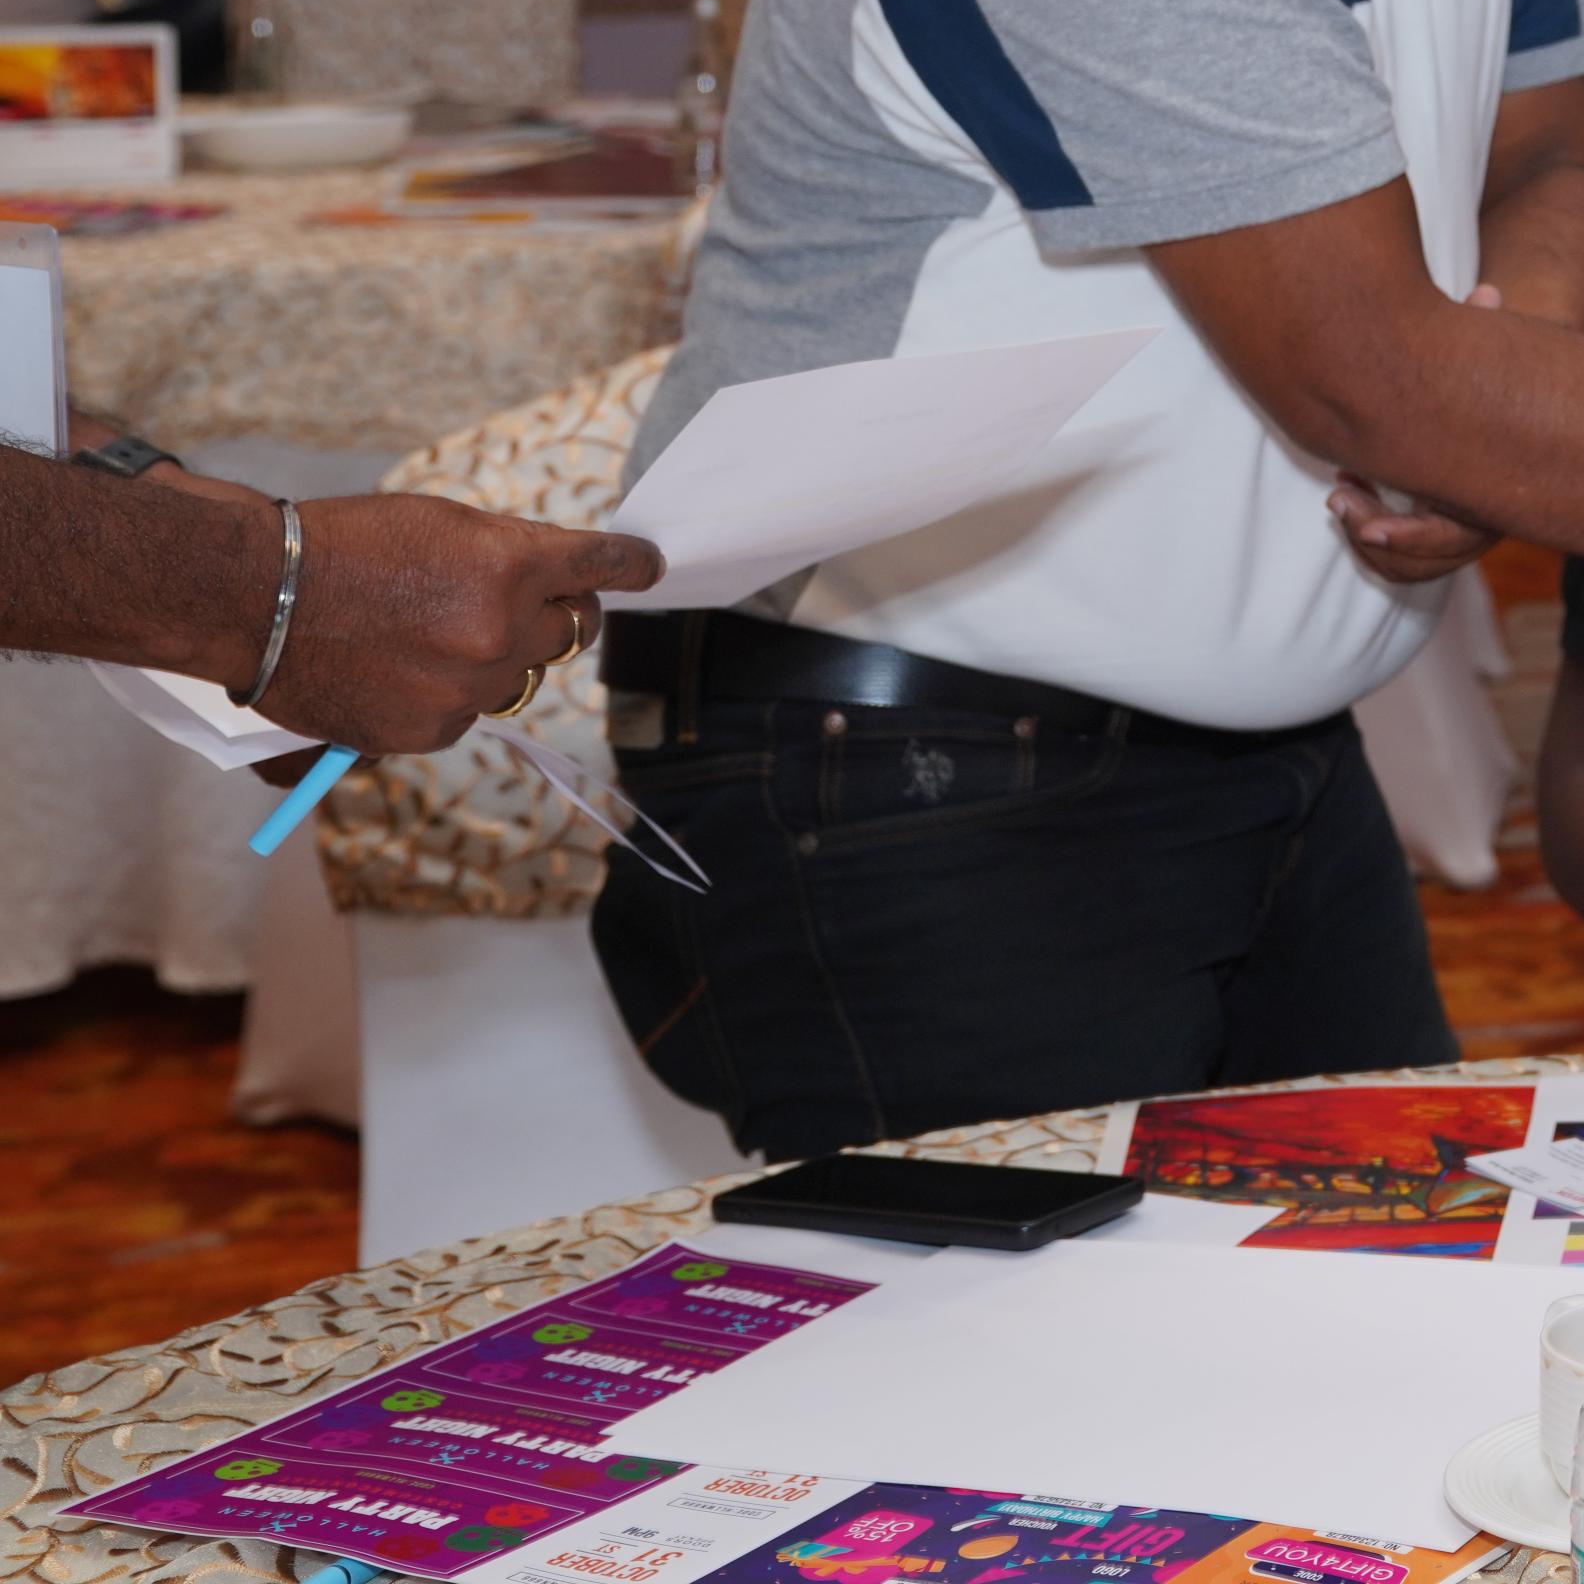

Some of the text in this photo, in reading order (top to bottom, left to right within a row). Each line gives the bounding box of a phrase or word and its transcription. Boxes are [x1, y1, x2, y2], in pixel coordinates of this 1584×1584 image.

[542, 1348, 649, 1376] NIGHT
[390, 1415, 500, 1440] NIGHT
[388, 1436, 550, 1471] HALLOWEEN
[703, 1477, 811, 1503] OCTOBER
[222, 1483, 460, 1531] PARTY NIGHT
[1064, 1506, 1106, 1525] HAPPY
[217, 1506, 388, 1538] HALLOWEEN
[622, 1525, 661, 1540] 9PM
[842, 1526, 898, 1544] 15%
[853, 1516, 915, 1534] OFF
[1008, 1518, 1186, 1557] GIFT VOUCHER
[547, 1551, 660, 1584] OCTOBER
[631, 1546, 685, 1567] 31
[1262, 1542, 1395, 1582] GIFT4YOU
[1091, 1564, 1131, 1578] LOGO
